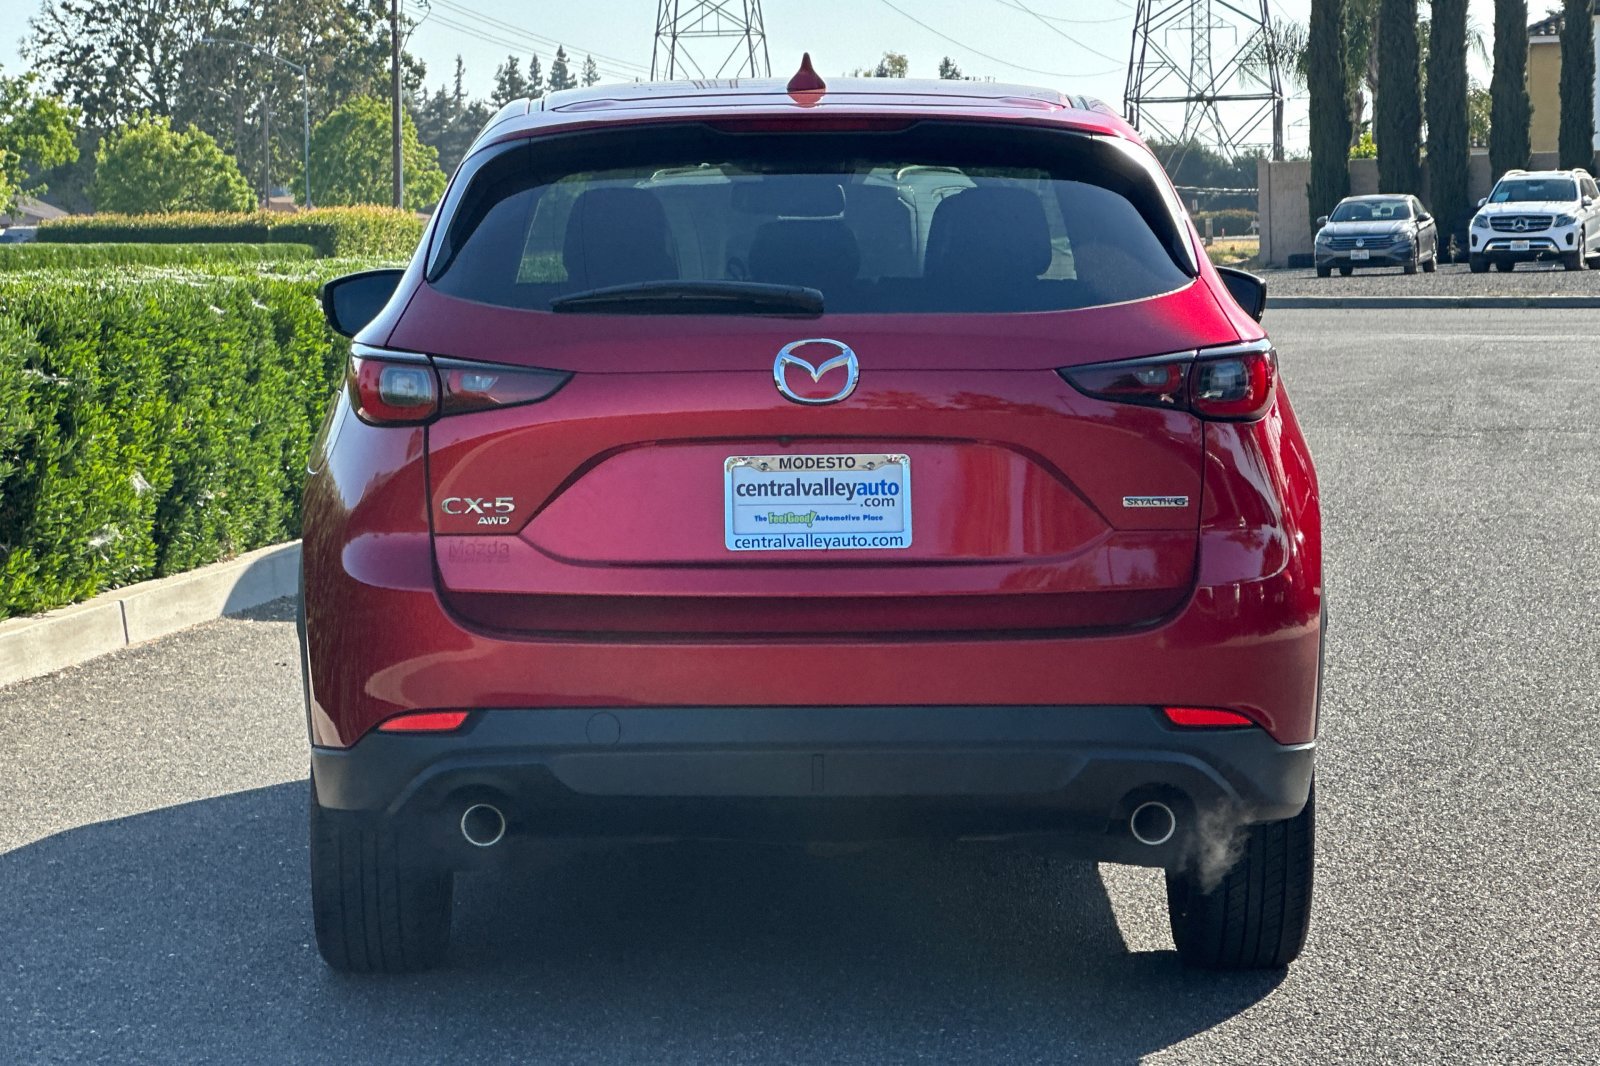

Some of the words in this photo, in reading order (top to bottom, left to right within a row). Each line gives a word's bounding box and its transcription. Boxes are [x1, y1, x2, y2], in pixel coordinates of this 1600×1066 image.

[779, 456, 856, 470] MODESTO
[736, 478, 900, 501] centralvalleyauto
[441, 497, 515, 514] CX-5
[860, 496, 895, 507] .com
[477, 516, 510, 525] AWD
[735, 533, 903, 549] centralvalleyauto.com
